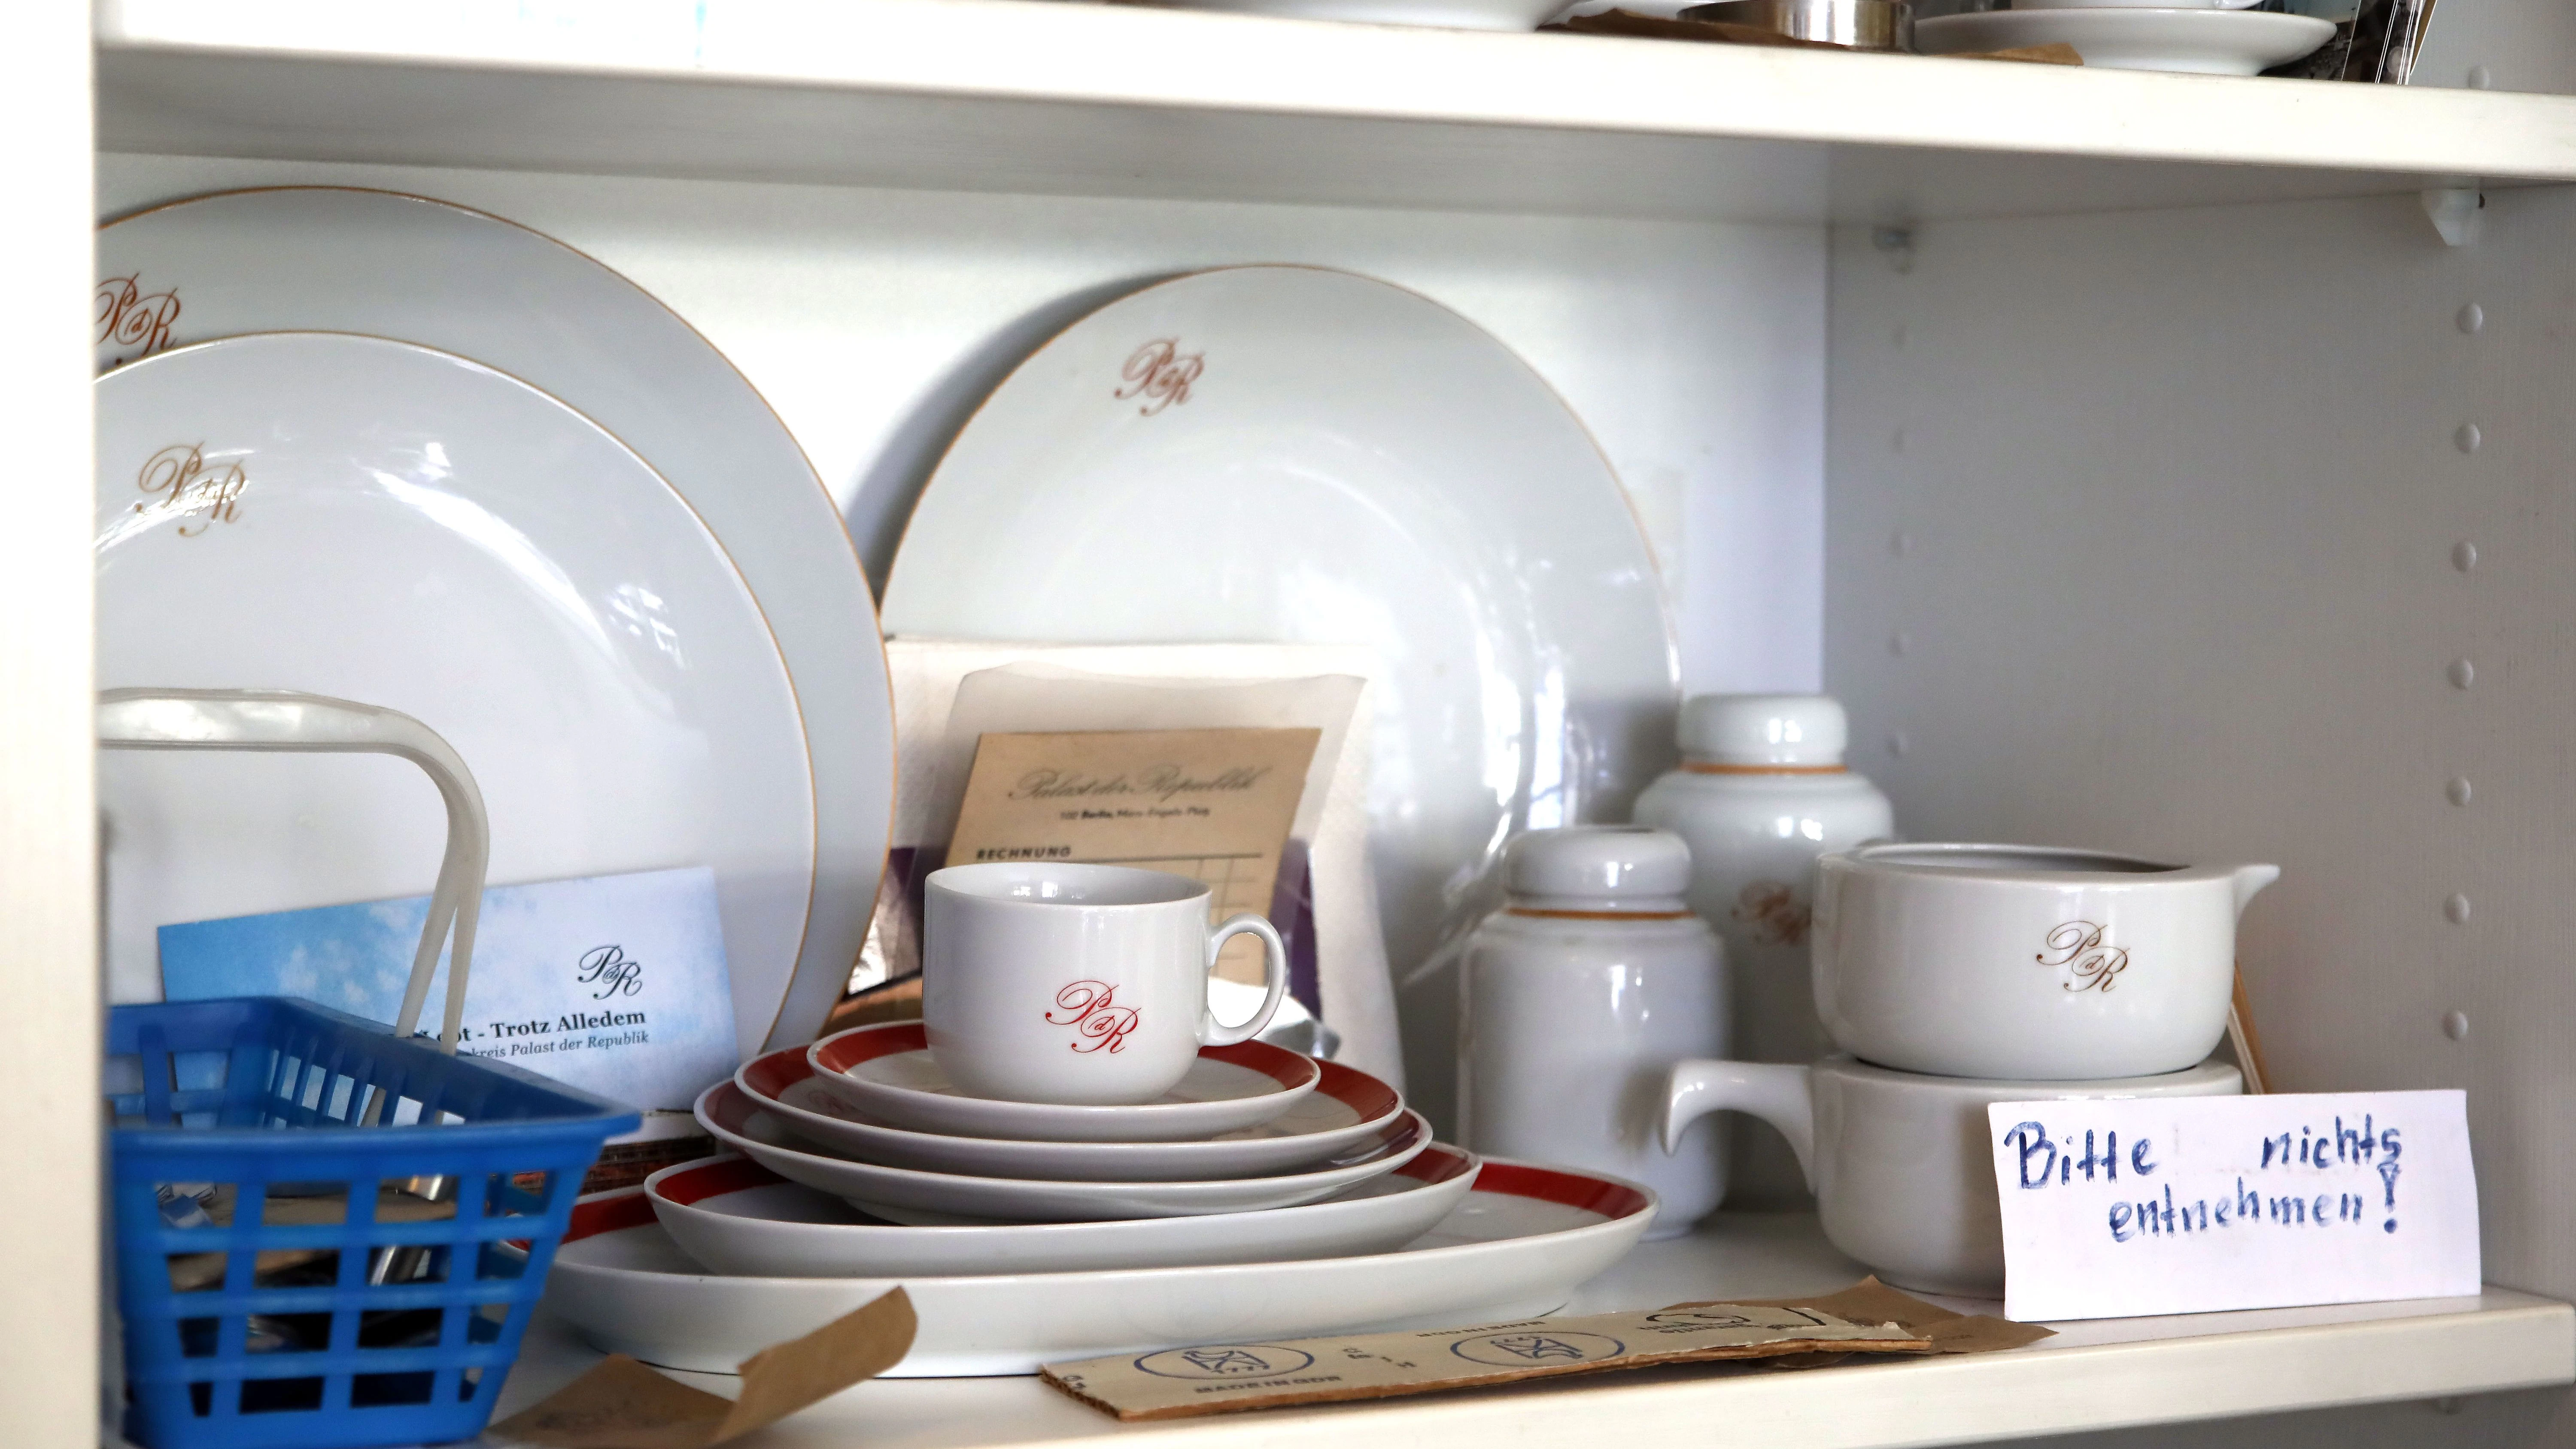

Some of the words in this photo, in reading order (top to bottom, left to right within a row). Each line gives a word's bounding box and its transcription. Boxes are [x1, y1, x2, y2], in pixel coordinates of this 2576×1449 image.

[976, 846, 1071, 860] RECHNUNG
[490, 1020, 551, 1038] Trotz
[557, 1011, 646, 1032] Alledem
[511, 1041, 555, 1057] Palast
[559, 1039, 583, 1051] der
[587, 1030, 649, 1050] Republik
[2004, 1120, 2159, 1190] Bitte
[2260, 1113, 2402, 1170] nichts
